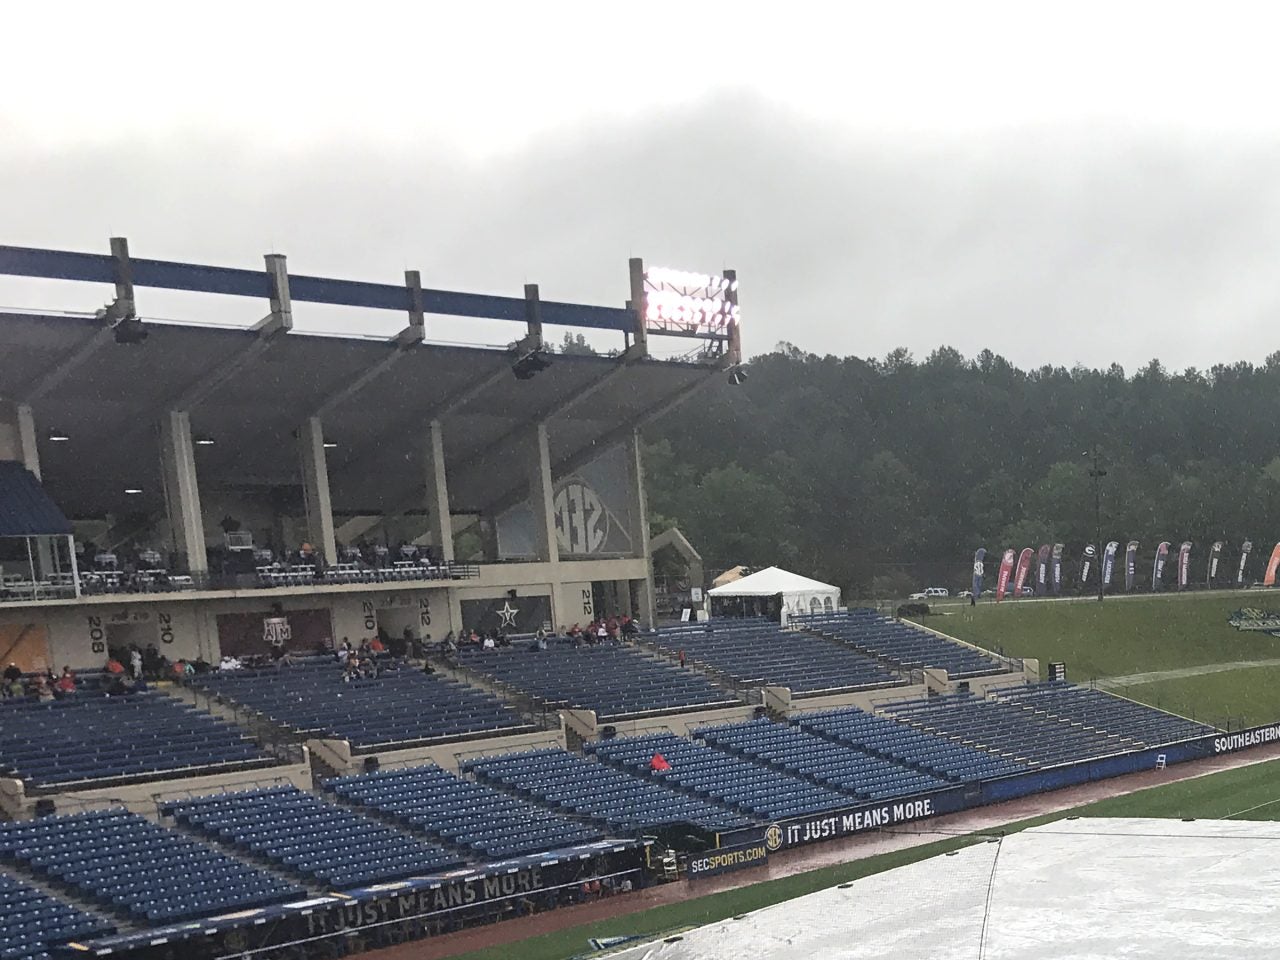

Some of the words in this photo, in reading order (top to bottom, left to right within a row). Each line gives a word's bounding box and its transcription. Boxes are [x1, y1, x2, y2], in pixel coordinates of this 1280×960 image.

[362, 600, 376, 630] 210
[419, 597, 431, 627] 212
[582, 590, 592, 616] 212
[88, 616, 105, 654] 208
[158, 612, 175, 645] 210
[788, 825, 801, 844] IT
[804, 818, 839, 841] JUST
[842, 807, 890, 832] MEANS
[893, 799, 935, 822] MORE.
[691, 846, 767, 873] SECSPORTS.COM
[334, 900, 388, 932] JUST
[400, 881, 477, 916] MEANS
